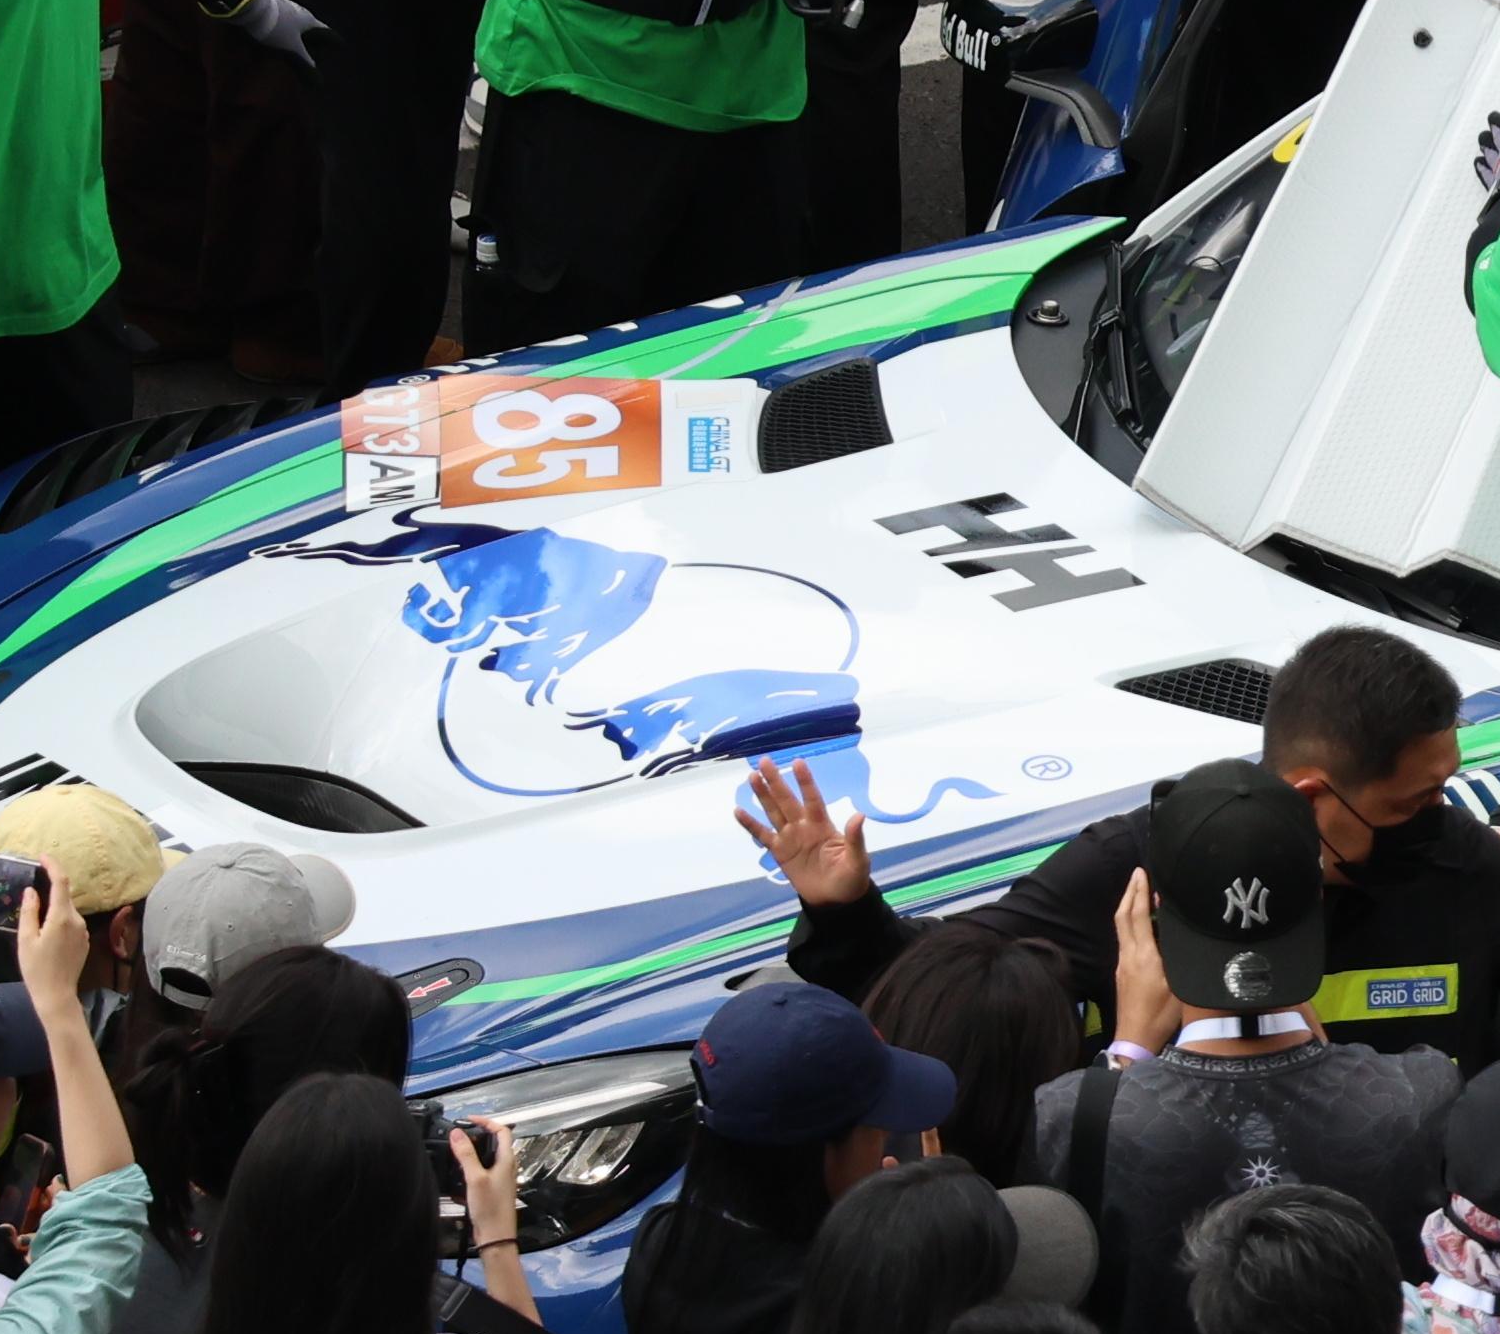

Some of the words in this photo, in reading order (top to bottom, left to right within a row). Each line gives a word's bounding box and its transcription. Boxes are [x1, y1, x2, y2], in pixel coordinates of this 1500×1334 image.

[956, 19, 990, 71] Bull
[362, 385, 420, 455] GT3
[472, 390, 622, 489] 85
[369, 459, 416, 505] AM
[1370, 988, 1408, 1005] GRID
[1413, 987, 1445, 1004] GRID
